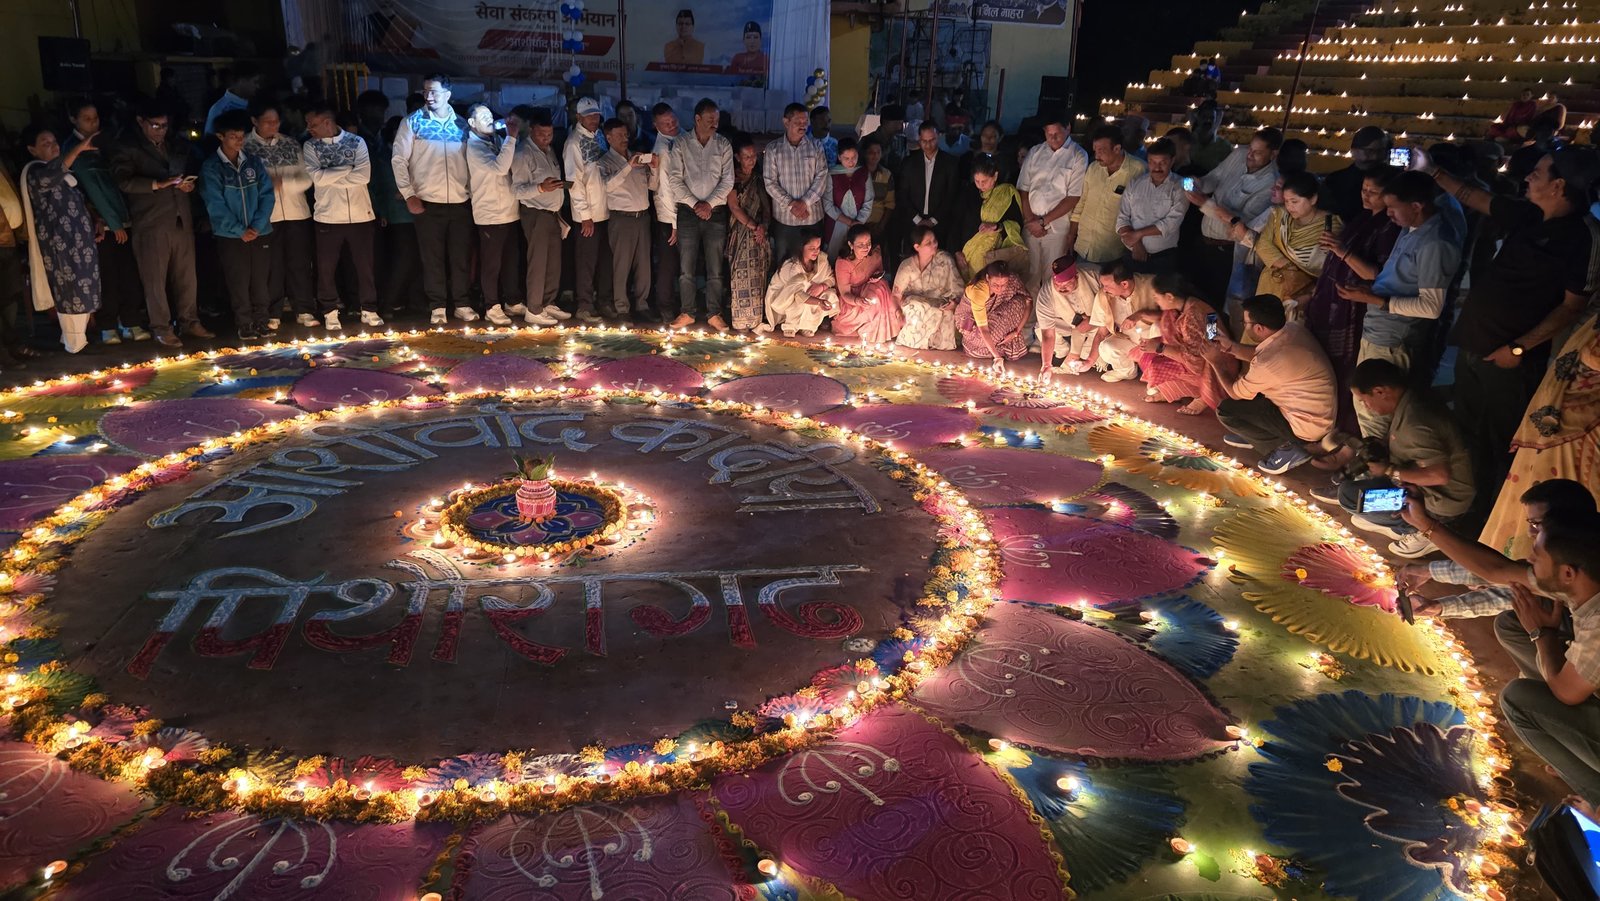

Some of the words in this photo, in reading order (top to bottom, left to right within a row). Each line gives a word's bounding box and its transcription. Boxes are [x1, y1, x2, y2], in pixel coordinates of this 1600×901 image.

[475, 1, 506, 20] सेवा
[509, 4, 557, 23] संकल्प
[146, 403, 598, 539] आशीर्वाद
